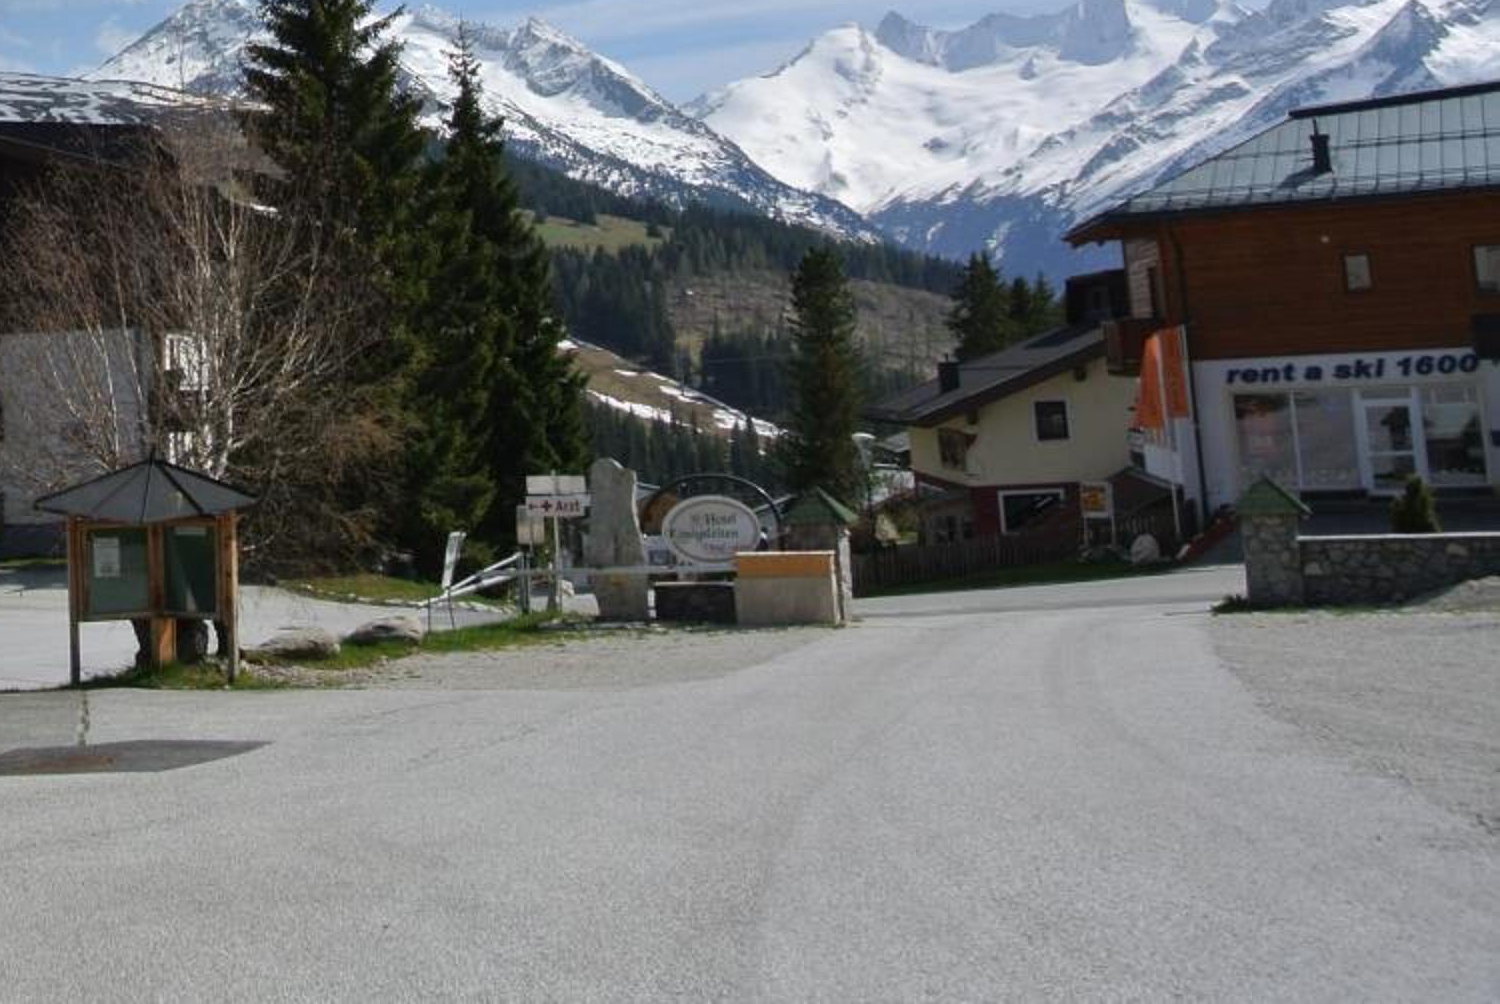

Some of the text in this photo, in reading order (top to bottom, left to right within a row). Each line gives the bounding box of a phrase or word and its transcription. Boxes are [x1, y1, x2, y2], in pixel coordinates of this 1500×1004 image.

[1226, 353, 1479, 384] rent a ski 1600
